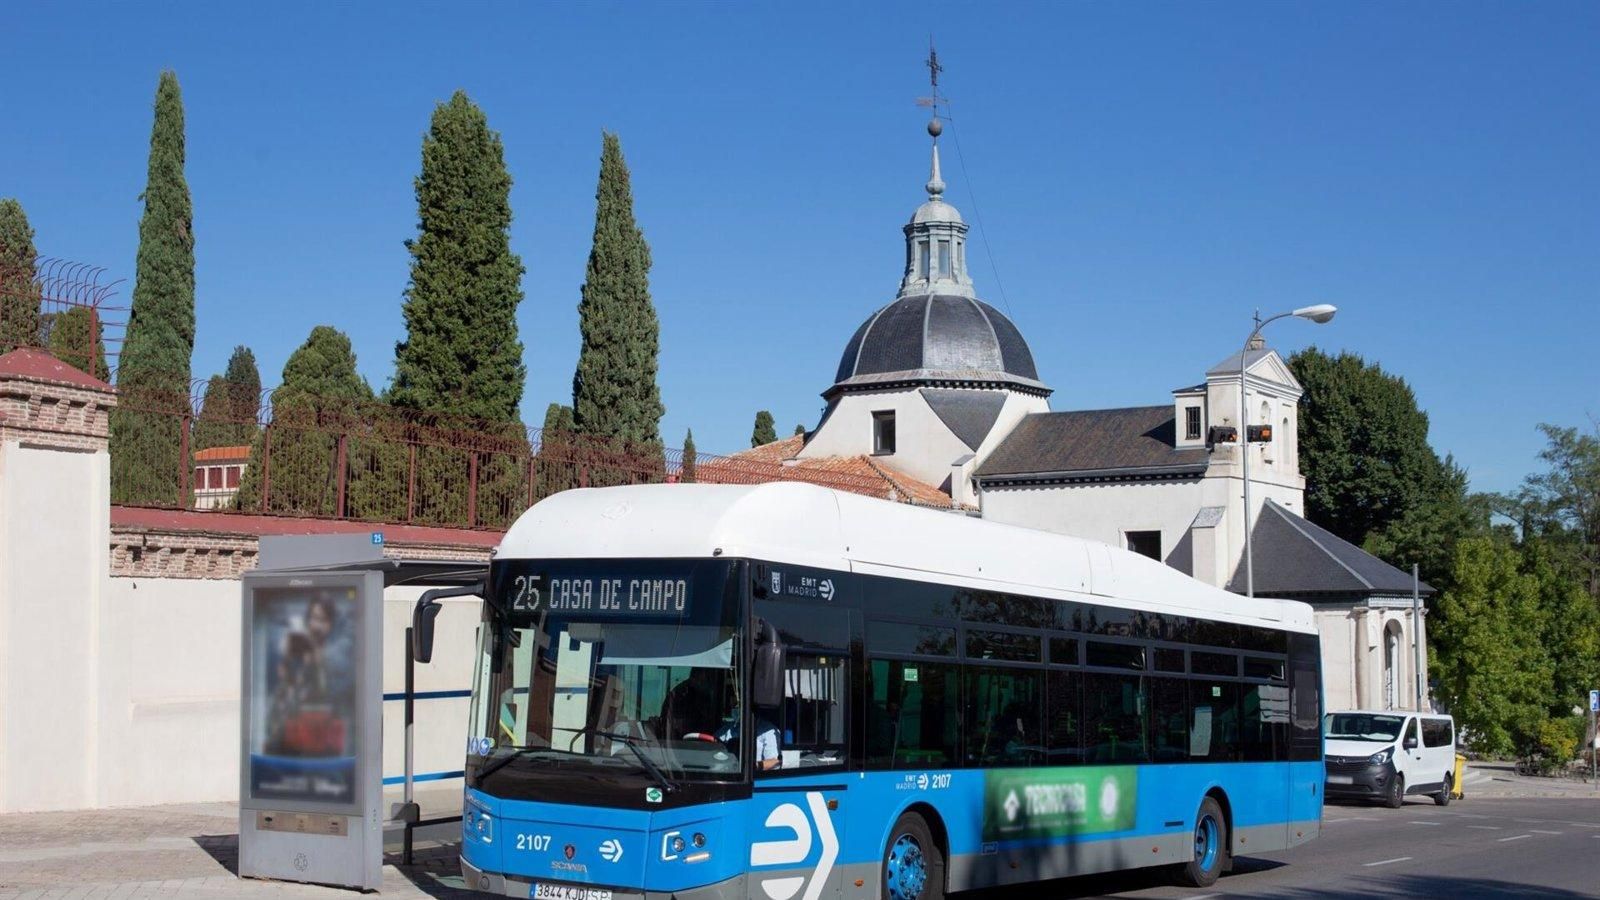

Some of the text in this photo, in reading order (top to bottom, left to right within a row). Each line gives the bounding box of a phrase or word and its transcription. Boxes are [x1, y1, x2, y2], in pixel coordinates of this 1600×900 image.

[374, 534, 382, 543] 25
[801, 577, 817, 587] EMT
[513, 575, 686, 611] 25 CASA DE CAMPO
[788, 585, 817, 597] MADRID
[905, 774, 917, 782] EMT
[932, 773, 952, 789] 2107
[895, 782, 917, 790] MADRID
[516, 834, 552, 851] 2107
[537, 883, 562, 899] 3844
